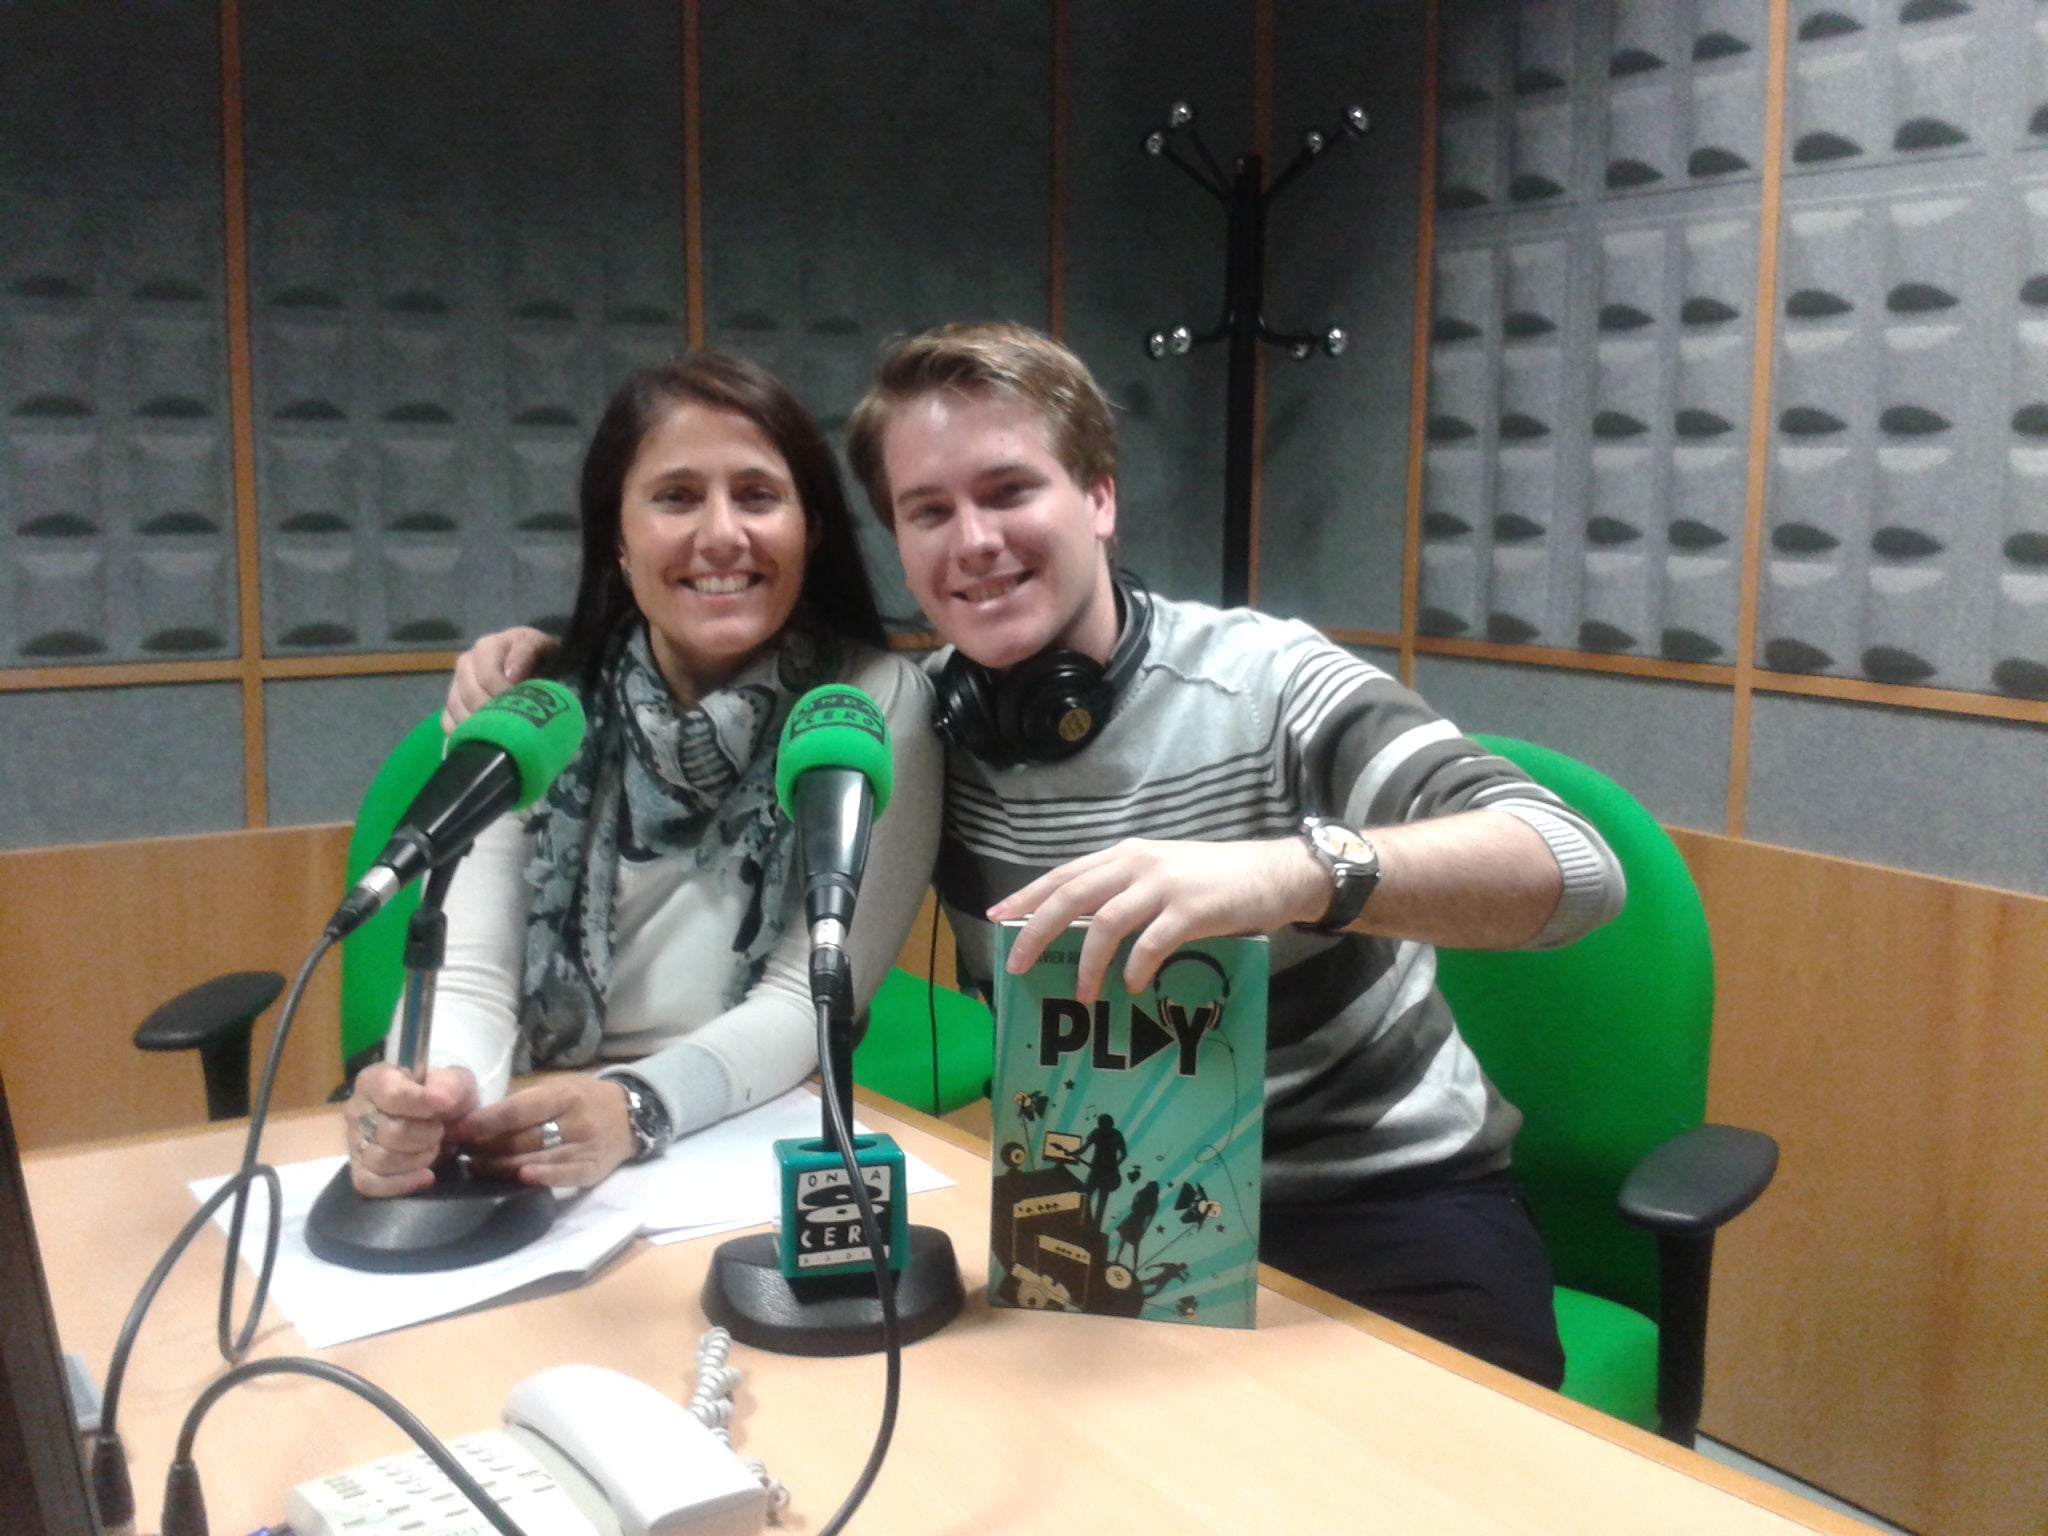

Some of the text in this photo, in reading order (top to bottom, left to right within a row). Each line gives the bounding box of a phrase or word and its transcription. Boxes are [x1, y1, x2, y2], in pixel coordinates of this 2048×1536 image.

[1040, 998, 1213, 1076] PLAY
[807, 1169, 883, 1188] ONA
[800, 1224, 862, 1248] CER
